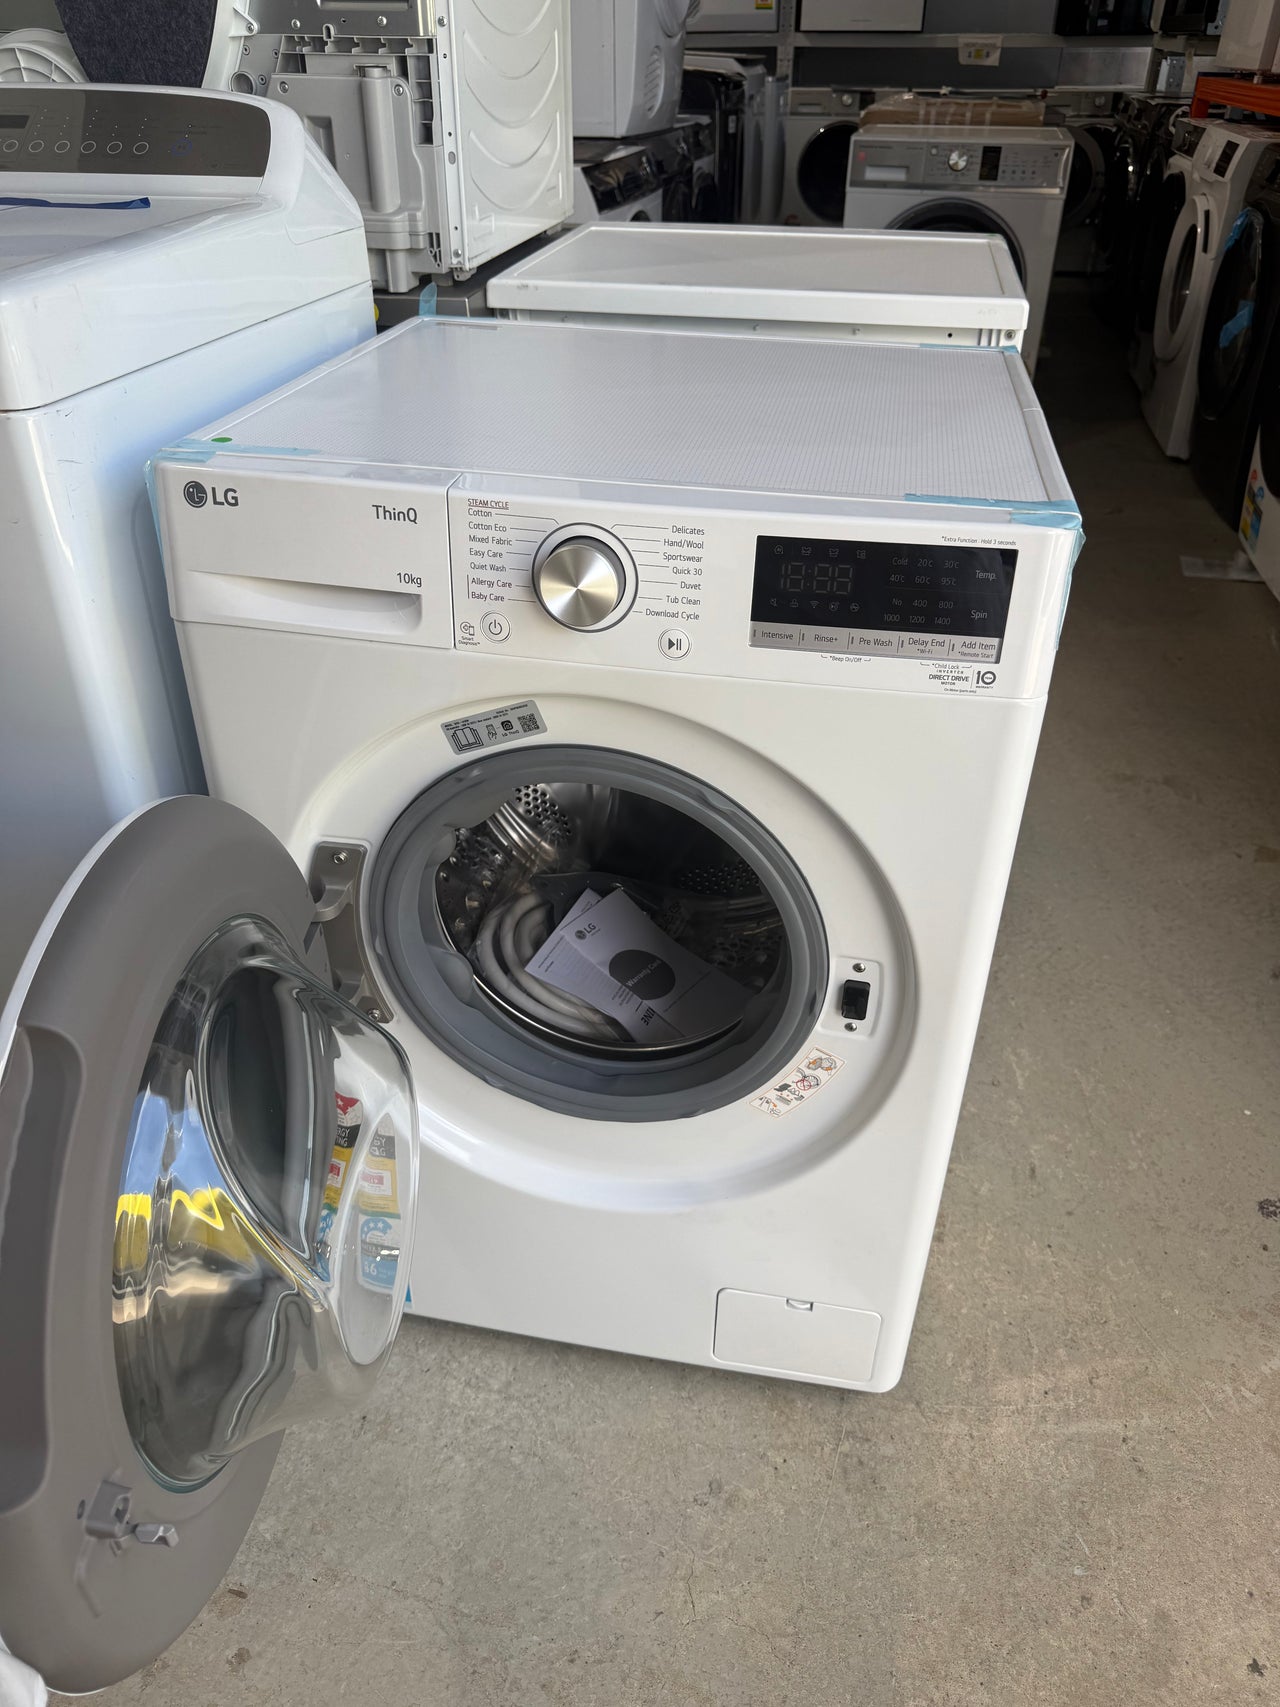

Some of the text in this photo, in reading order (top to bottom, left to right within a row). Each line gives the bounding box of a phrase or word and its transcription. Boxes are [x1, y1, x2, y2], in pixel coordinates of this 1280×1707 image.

[211, 486, 239, 507] LG
[467, 498, 509, 509] STEAM CYCLE
[371, 504, 418, 525] ThinQ
[467, 507, 493, 518] Cotton
[468, 521, 507, 532] Cotton Eco
[671, 524, 705, 536] Delicates
[468, 534, 513, 546] Mixed Fabric
[663, 538, 704, 550] Hand/Wool
[469, 547, 504, 559] Easy Care
[662, 551, 704, 563] Sportswear
[470, 561, 507, 572] Quiet Wash
[891, 556, 909, 567] Cold
[672, 566, 703, 576] Quick 30
[975, 569, 998, 581] Temp.
[397, 572, 422, 588] 10kg
[471, 577, 513, 589] Allergy Care
[680, 580, 702, 591] Duvet
[471, 591, 505, 602] Baby Care
[665, 595, 701, 606] Tub Clean
[891, 598, 954, 609] No 400 800
[645, 607, 700, 621] Download Cycle
[883, 613, 951, 625] 1000 1200 1400
[970, 609, 988, 620] Spin
[761, 630, 794, 640] Intensive
[814, 633, 838, 643] Rinse+
[858, 636, 893, 647] Pre Wash
[908, 637, 946, 648] Delay End
[960, 640, 996, 651] Add Item
[928, 673, 950, 681] DIRECT
[975, 670, 997, 686] 10
[583, 922, 597, 934] LG
[625, 967, 651, 987] Warranty
